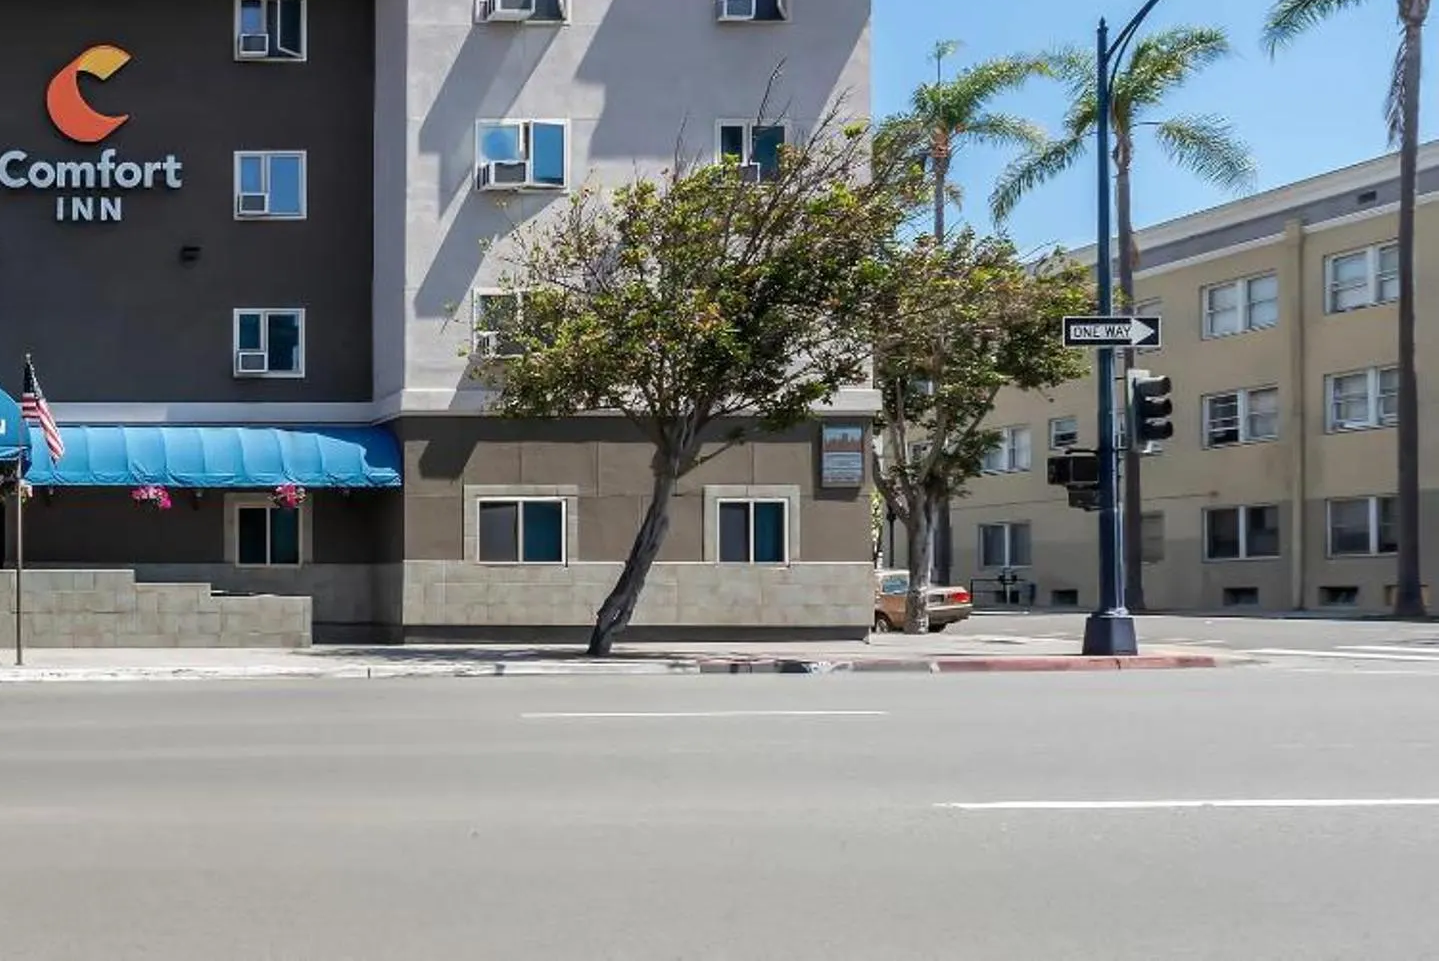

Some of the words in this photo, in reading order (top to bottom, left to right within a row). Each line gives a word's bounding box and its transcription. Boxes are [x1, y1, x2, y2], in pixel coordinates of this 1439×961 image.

[56, 196, 122, 222] INN
[1073, 326, 1101, 338] ONE
[1104, 325, 1131, 338] WAY
